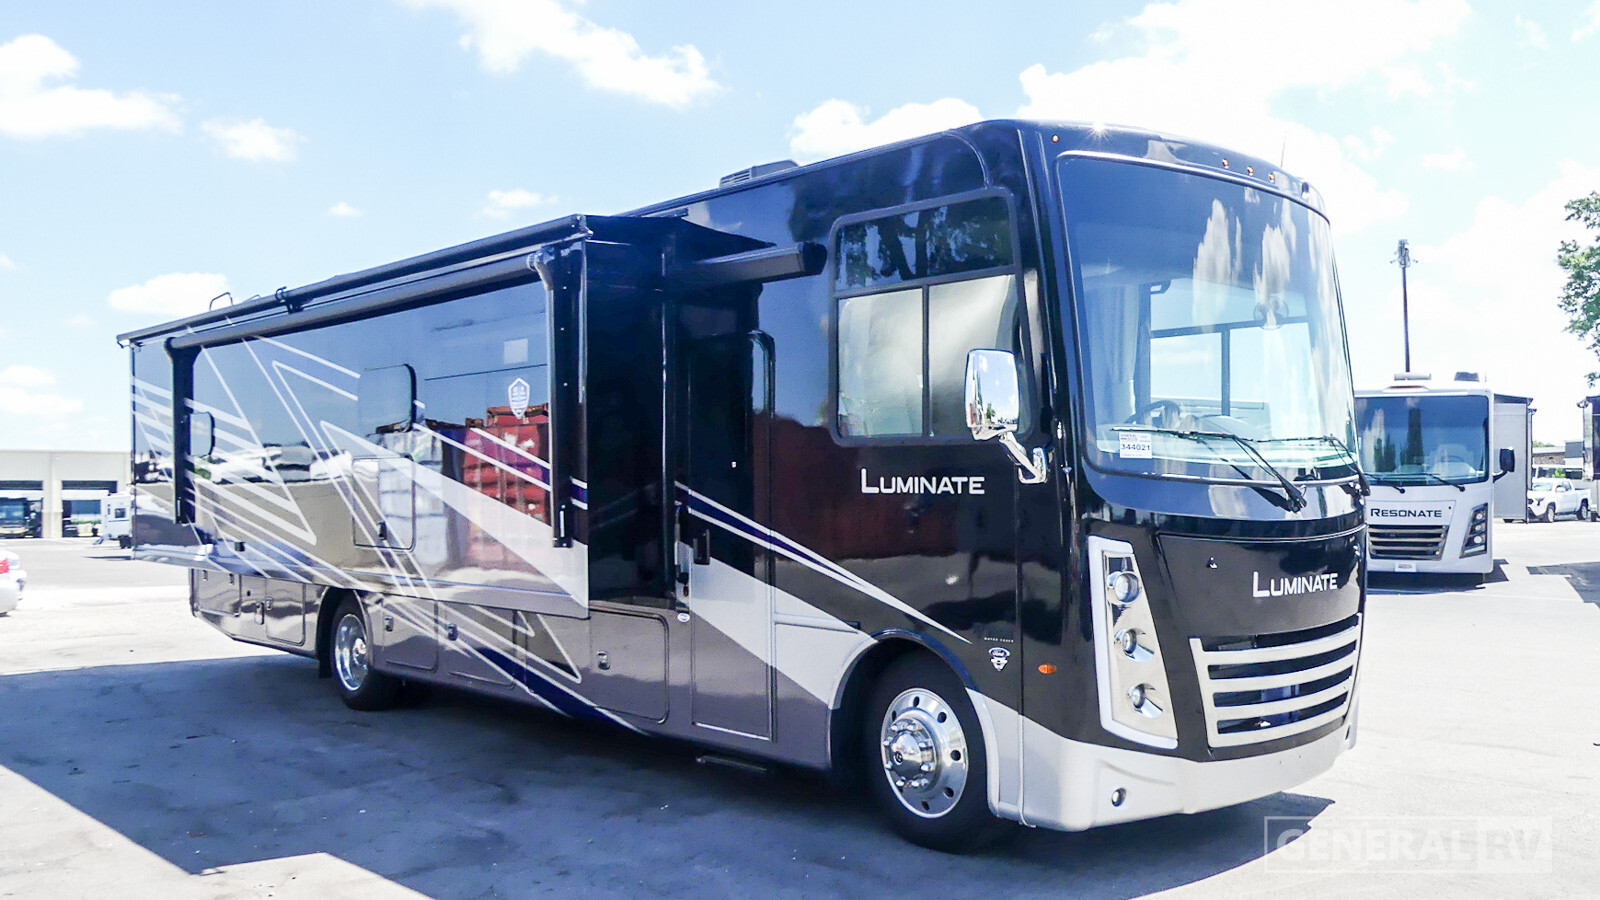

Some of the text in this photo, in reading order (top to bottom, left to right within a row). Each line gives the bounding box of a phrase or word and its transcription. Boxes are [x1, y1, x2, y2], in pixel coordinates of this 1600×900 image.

[1120, 443, 1151, 451] 344021
[860, 468, 986, 495] LUMINATE
[1370, 508, 1442, 518] RESONATE
[1252, 571, 1339, 598] LUMINATE
